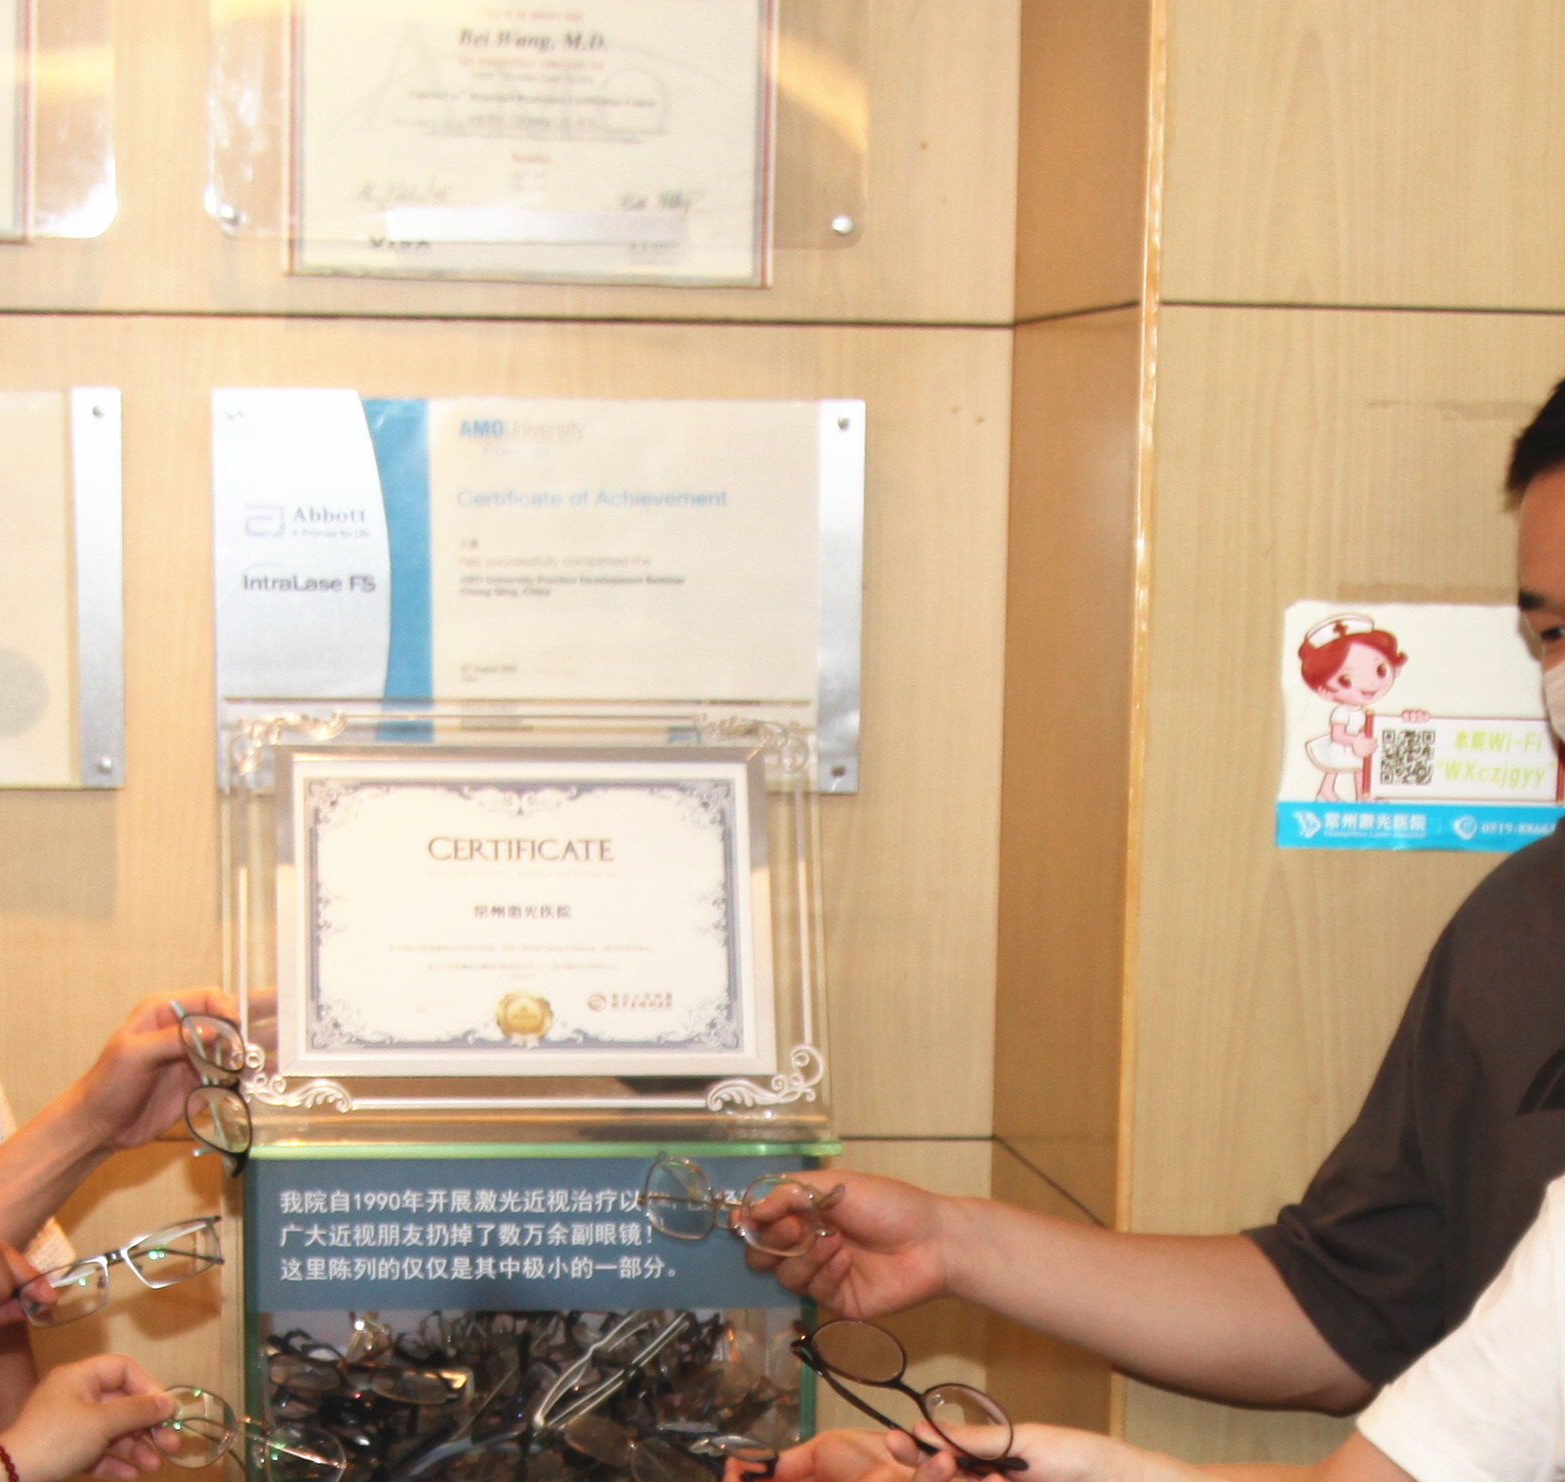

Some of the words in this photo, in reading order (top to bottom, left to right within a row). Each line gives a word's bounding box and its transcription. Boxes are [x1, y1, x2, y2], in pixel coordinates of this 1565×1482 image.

[459, 28, 489, 48] Bei
[458, 489, 563, 508] Certificate
[570, 488, 592, 508] of
[596, 488, 728, 508] Achievement
[293, 506, 367, 523] Abbott
[242, 574, 343, 593] IntraLase
[350, 574, 377, 593] FS
[1324, 811, 1427, 831] 常州激光医院
[427, 836, 615, 861] CERTIFICATE
[474, 904, 572, 920] 常州激光医院
[280, 1222, 654, 1248] 广大近视朋友扔掉了数万余副眼镜！
[280, 1256, 678, 1282] 这里陈列的仅仅是其中极小的一部分。
